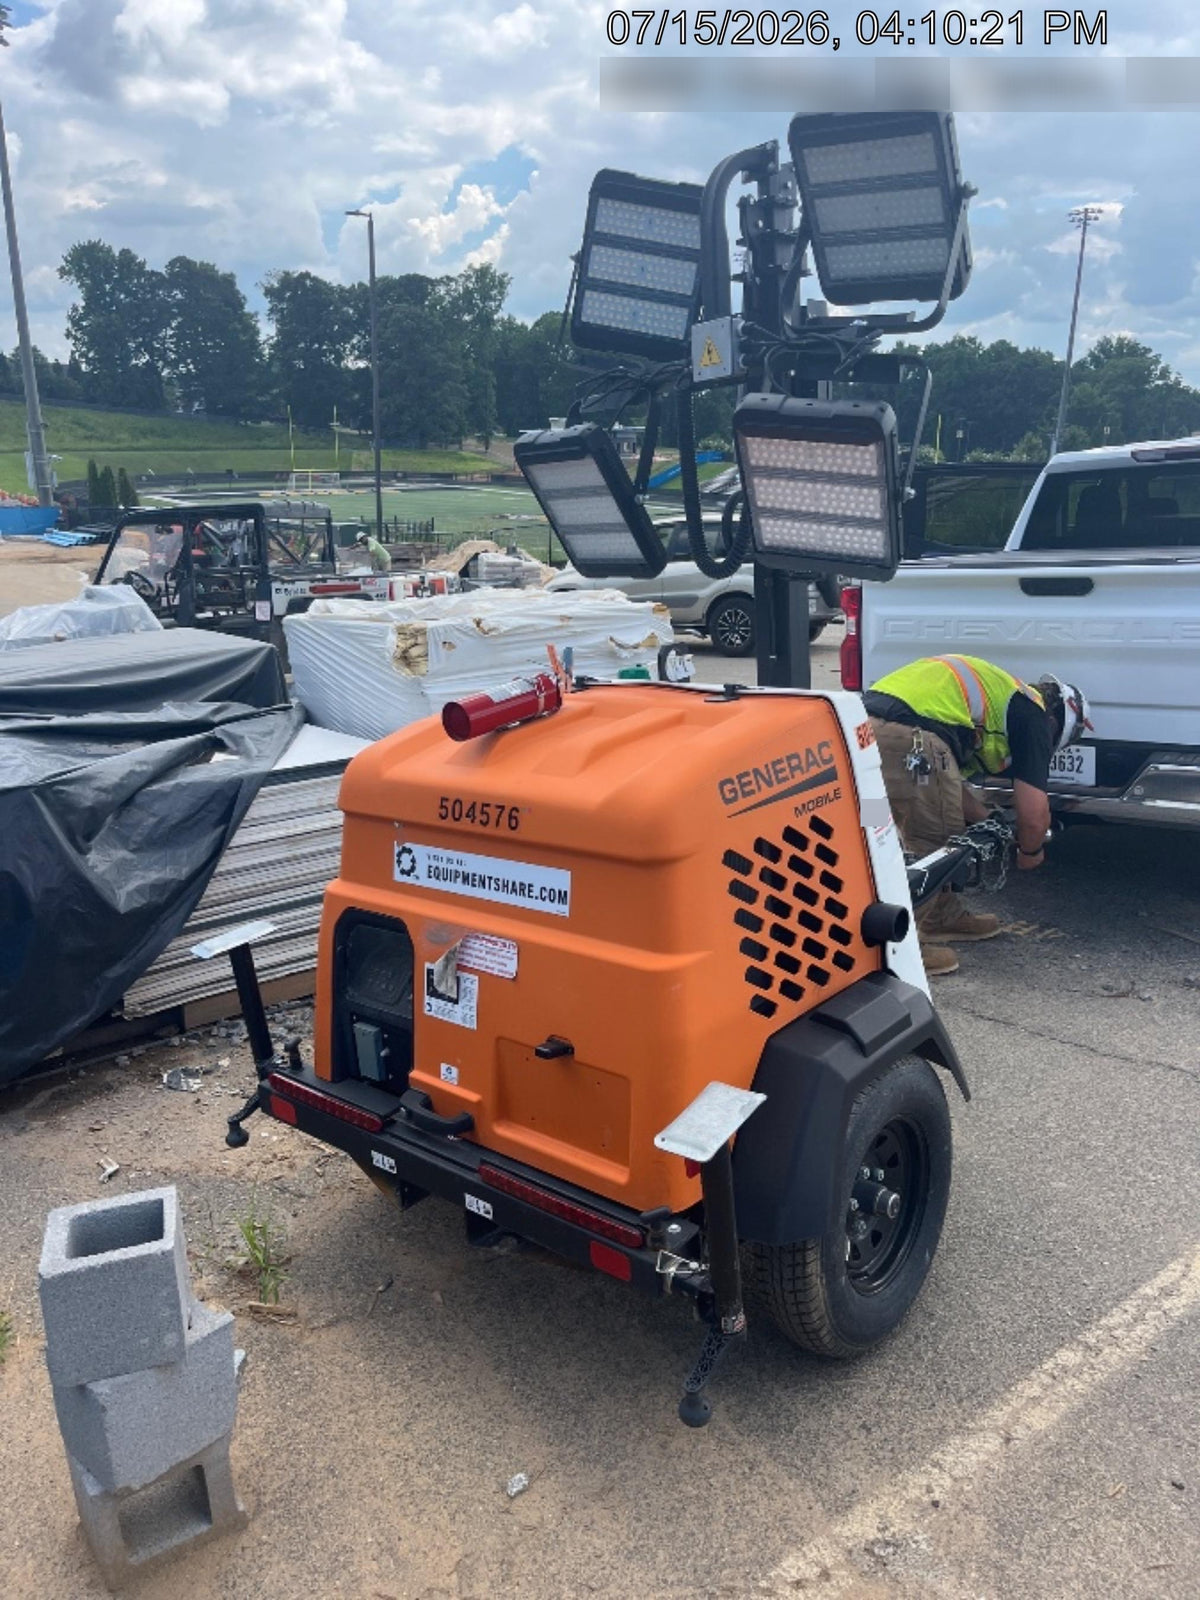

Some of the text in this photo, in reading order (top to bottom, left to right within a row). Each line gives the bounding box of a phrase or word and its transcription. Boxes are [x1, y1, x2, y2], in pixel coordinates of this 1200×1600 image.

[718, 740, 835, 806] GENERAC
[438, 796, 520, 831] 504576
[793, 787, 842, 819] MOBILE
[426, 865, 568, 906] EQUIPMENTSHARE.COM
